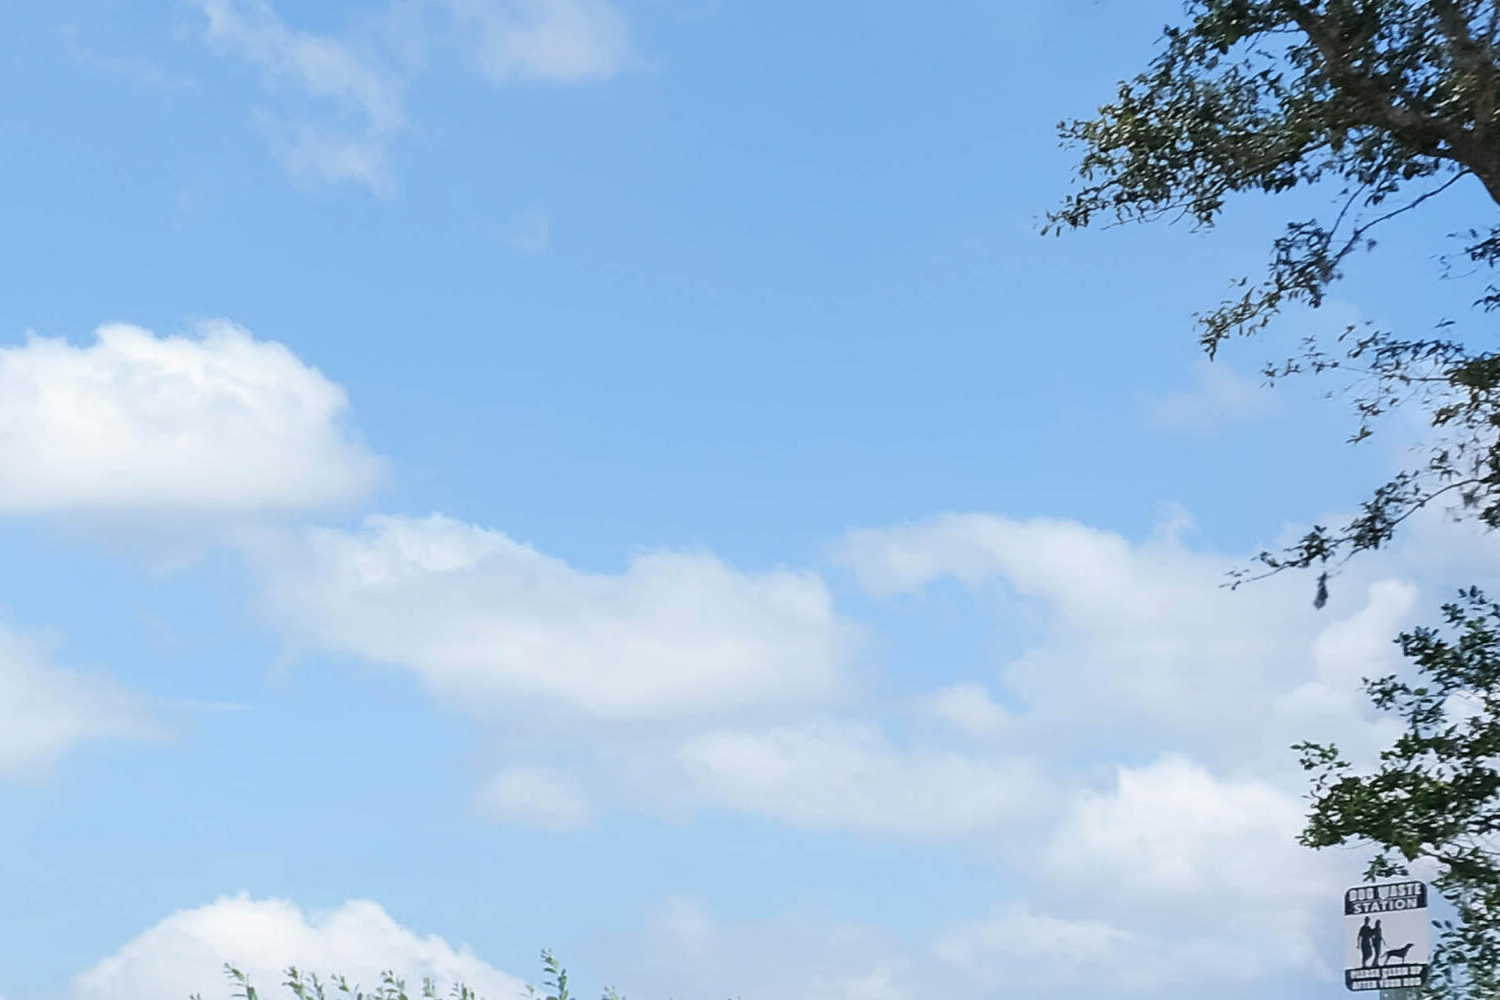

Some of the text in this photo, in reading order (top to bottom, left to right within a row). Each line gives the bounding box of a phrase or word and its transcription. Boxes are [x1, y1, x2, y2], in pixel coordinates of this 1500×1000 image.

[1349, 883, 1422, 902] DOG WASTE
[1354, 898, 1418, 914] STATION
